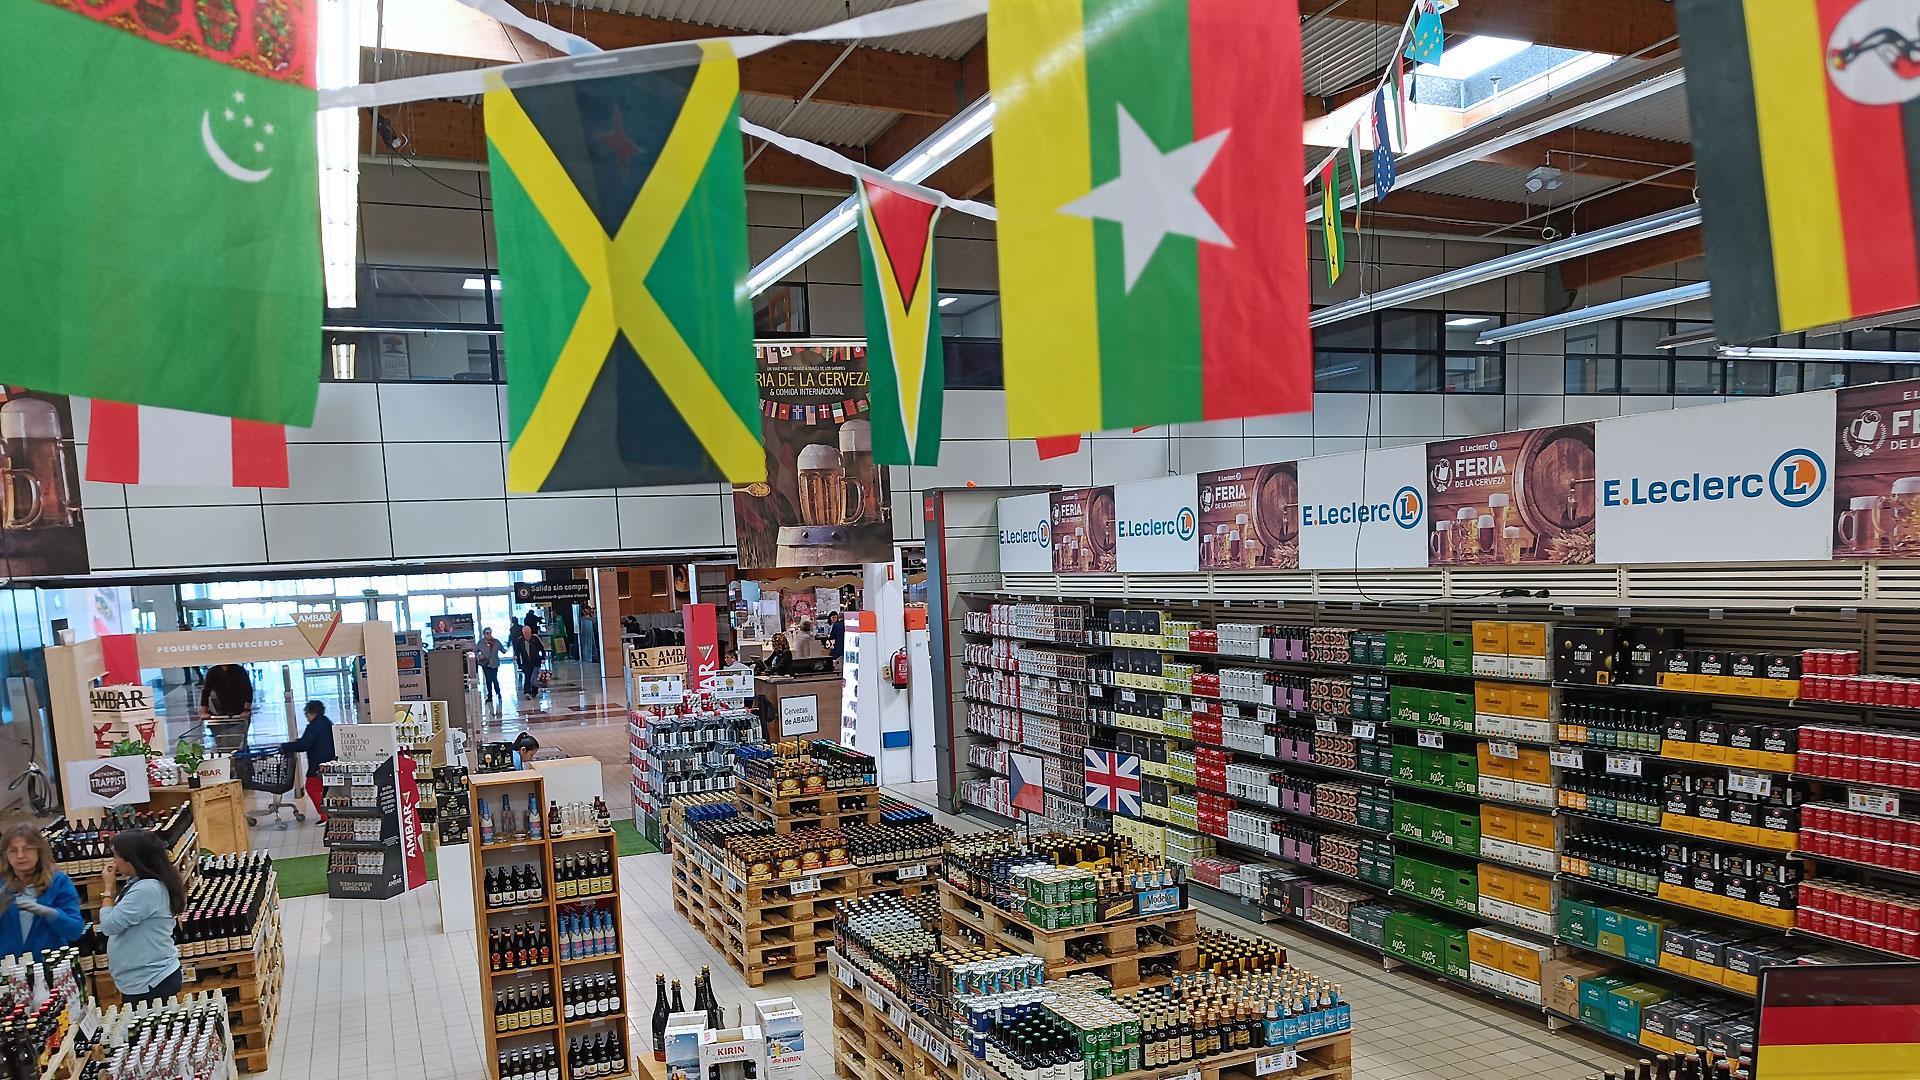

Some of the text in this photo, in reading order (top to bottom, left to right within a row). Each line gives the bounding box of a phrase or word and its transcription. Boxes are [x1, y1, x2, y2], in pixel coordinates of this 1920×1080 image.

[755, 372, 870, 387] RIA DE LA CERVEZA
[776, 388, 798, 396] COMIDA
[800, 388, 844, 396] INTERNACIONAL
[1890, 440, 1908, 450] DE
[1455, 455, 1506, 478] FERIA
[1455, 480, 1464, 488] DE
[1476, 476, 1506, 486] CERVEZA
[1215, 484, 1246, 500] FERIA
[1604, 472, 1763, 507] E.Leclerc
[1061, 502, 1082, 517] FERIA
[1303, 502, 1390, 526] E.Leclerc
[1118, 520, 1175, 537] E.Leclerc
[1000, 528, 1037, 544] E.Leclerc
[298, 614, 332, 623] AMBAR
[157, 639, 284, 653] PEQUEÑOS CERVECEROS
[1701, 660, 1721, 668] Estrella
[89, 690, 148, 709] AMBAR
[784, 707, 808, 715] Cervezas
[1399, 708, 1412, 720] 1925
[1428, 712, 1442, 725] 1925
[198, 769, 221, 777] MBAR
[1400, 767, 1413, 780] 1925
[1430, 772, 1444, 785] 1925
[90, 776, 125, 787] TRAPPIST
[1668, 801, 1686, 809] Estrella
[1765, 816, 1787, 824] Estrella
[403, 802, 416, 858] AMBAR
[1664, 871, 1682, 880] Estrella
[1401, 878, 1414, 892] 1925
[1695, 878, 1714, 886] Estrella
[1431, 886, 1444, 900] 1925
[1726, 884, 1746, 894] Estrella
[1147, 893, 1170, 905] Modelo
[1760, 892, 1780, 900] Estrella
[1665, 940, 1683, 950] Estrella
[1696, 948, 1715, 958] Estrella
[1729, 957, 1749, 967] Estrella
[1646, 1019, 1664, 1029] Estrella
[1676, 1029, 1695, 1038] Estrella
[717, 1046, 745, 1056] KIRIN
